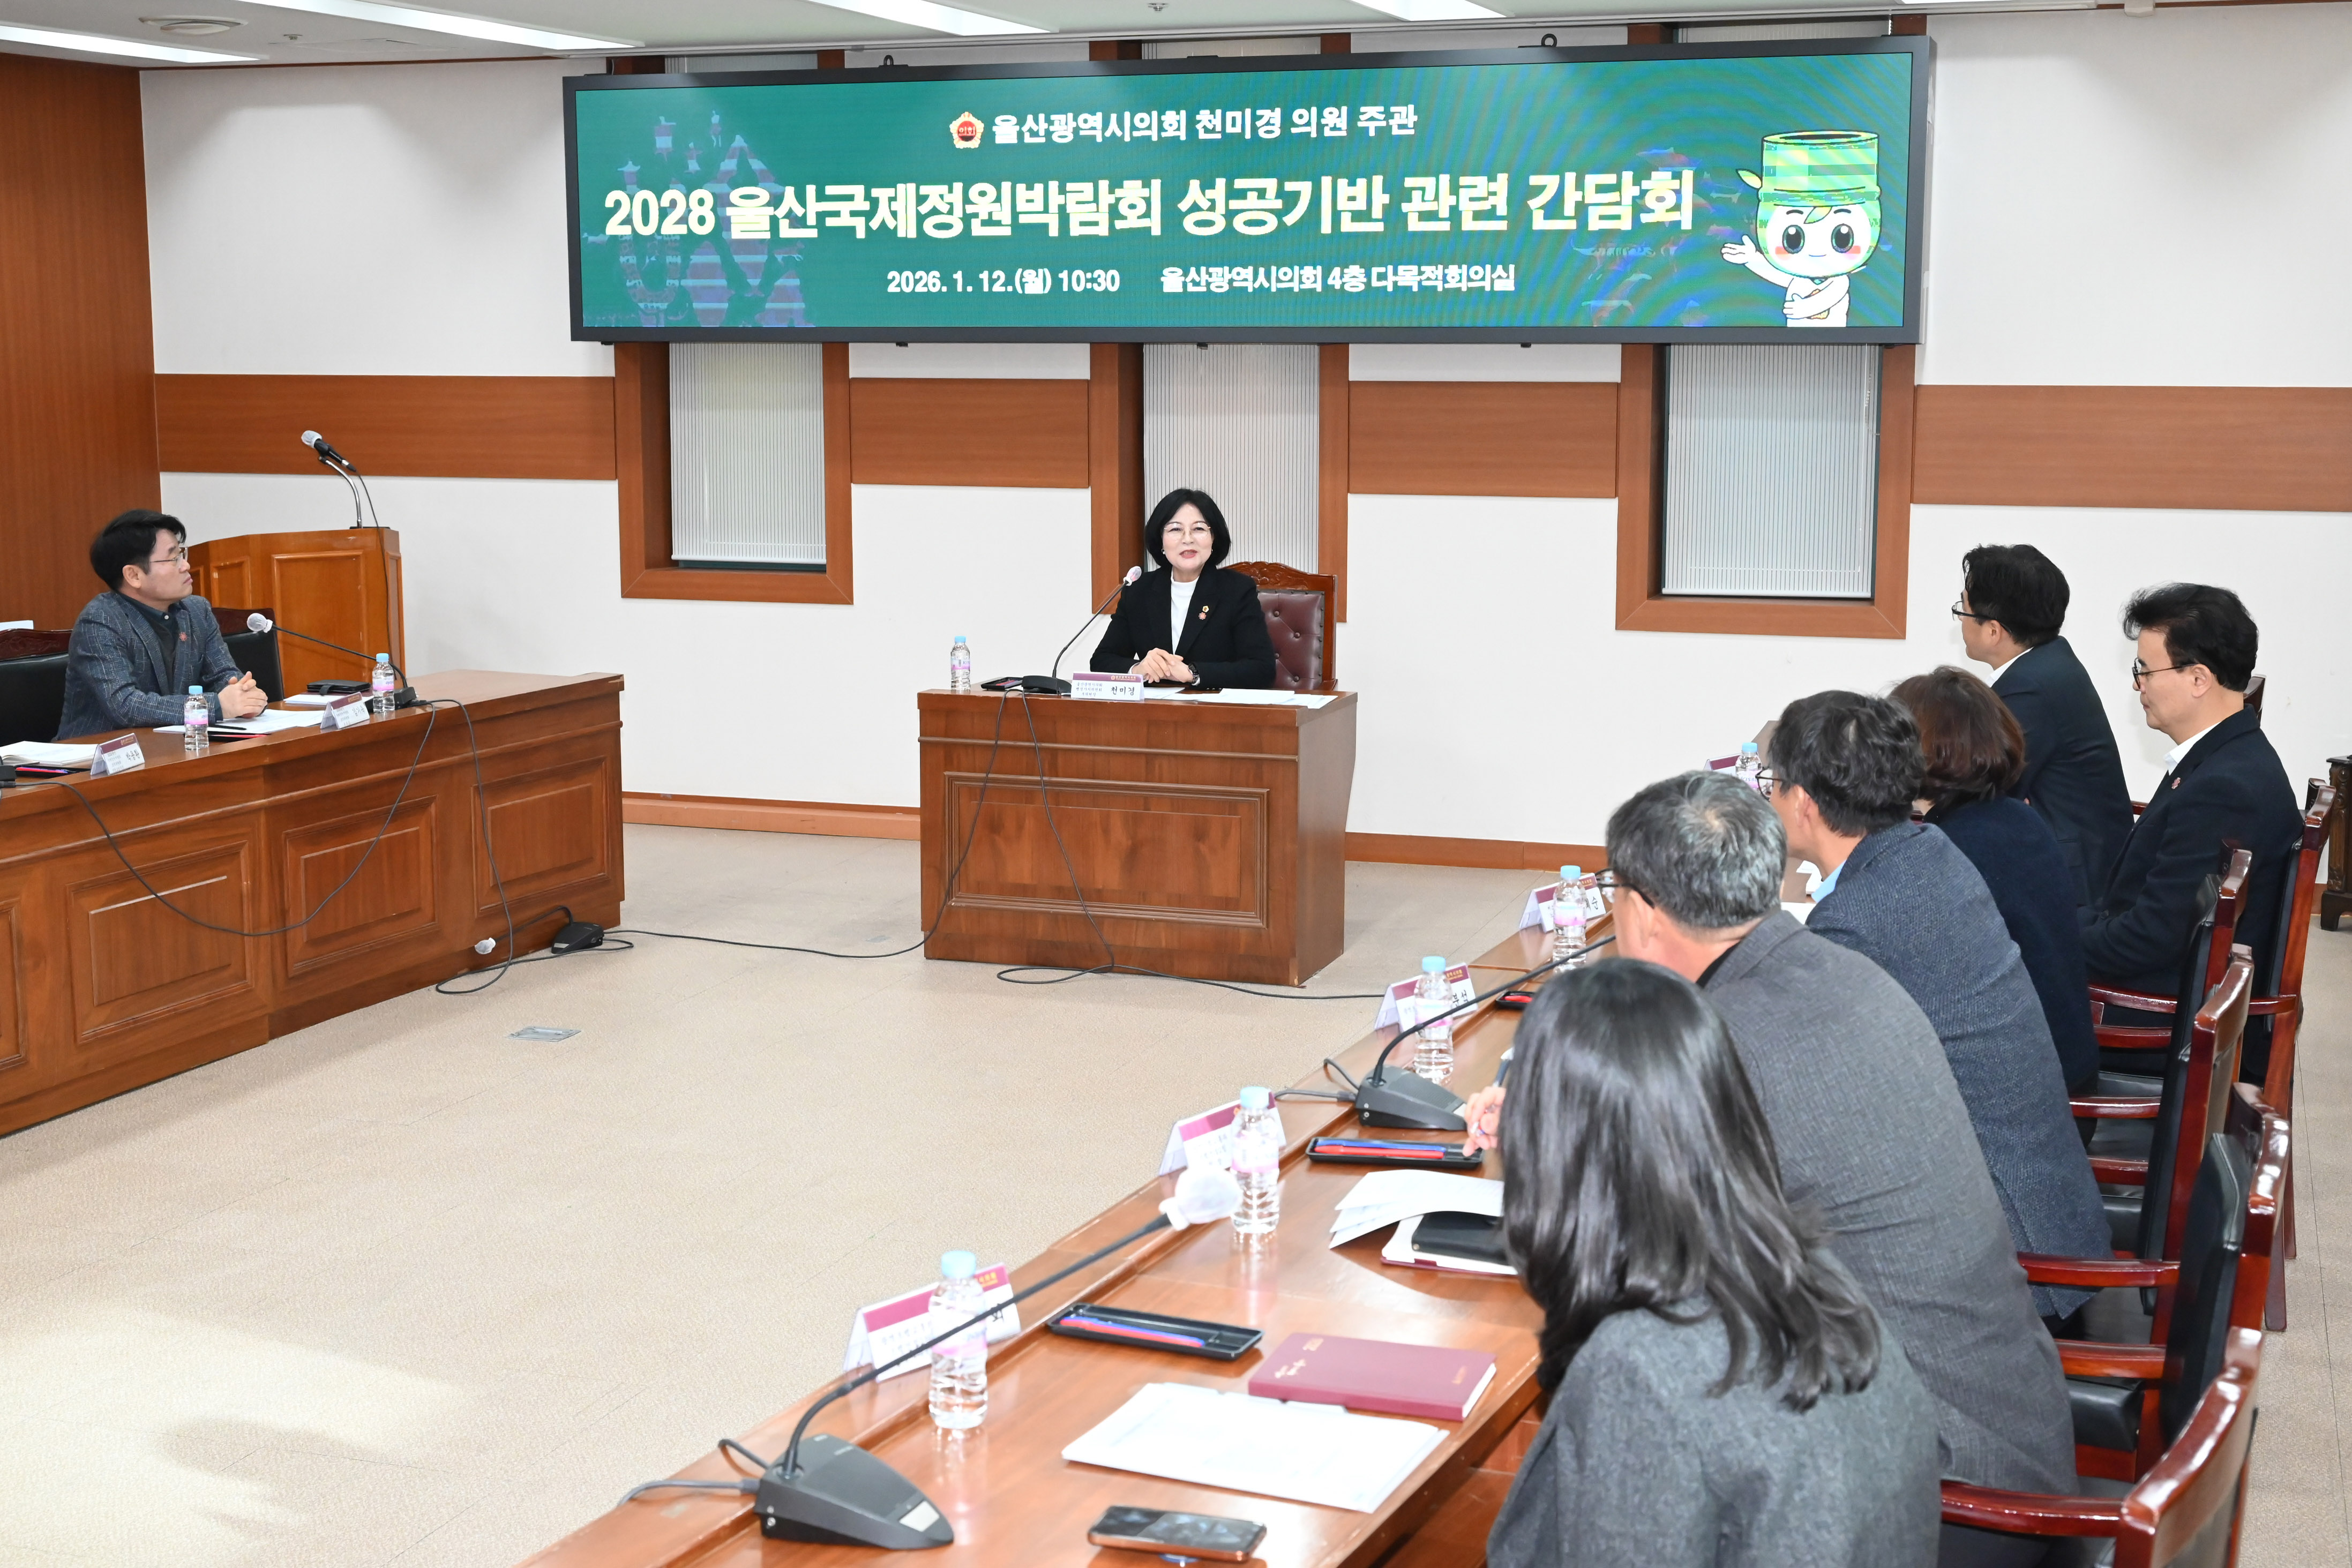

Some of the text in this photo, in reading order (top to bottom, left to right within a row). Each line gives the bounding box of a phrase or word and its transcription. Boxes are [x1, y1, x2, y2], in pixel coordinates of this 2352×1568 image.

[992, 103, 1418, 145] 울산광역시의회 천미경 의원 주관
[604, 169, 1694, 240] 2028 울산국제정원박람회 성공기반 관련 간담회
[887, 270, 948, 294] 2026.
[952, 270, 973, 292] 1.
[1058, 268, 1121, 292] 10:30
[1160, 265, 1323, 294] 울산광역시의회
[1327, 264, 1367, 293] 4층
[1370, 263, 1516, 292] 다목적회의실
[1111, 685, 1135, 696] 천미경
